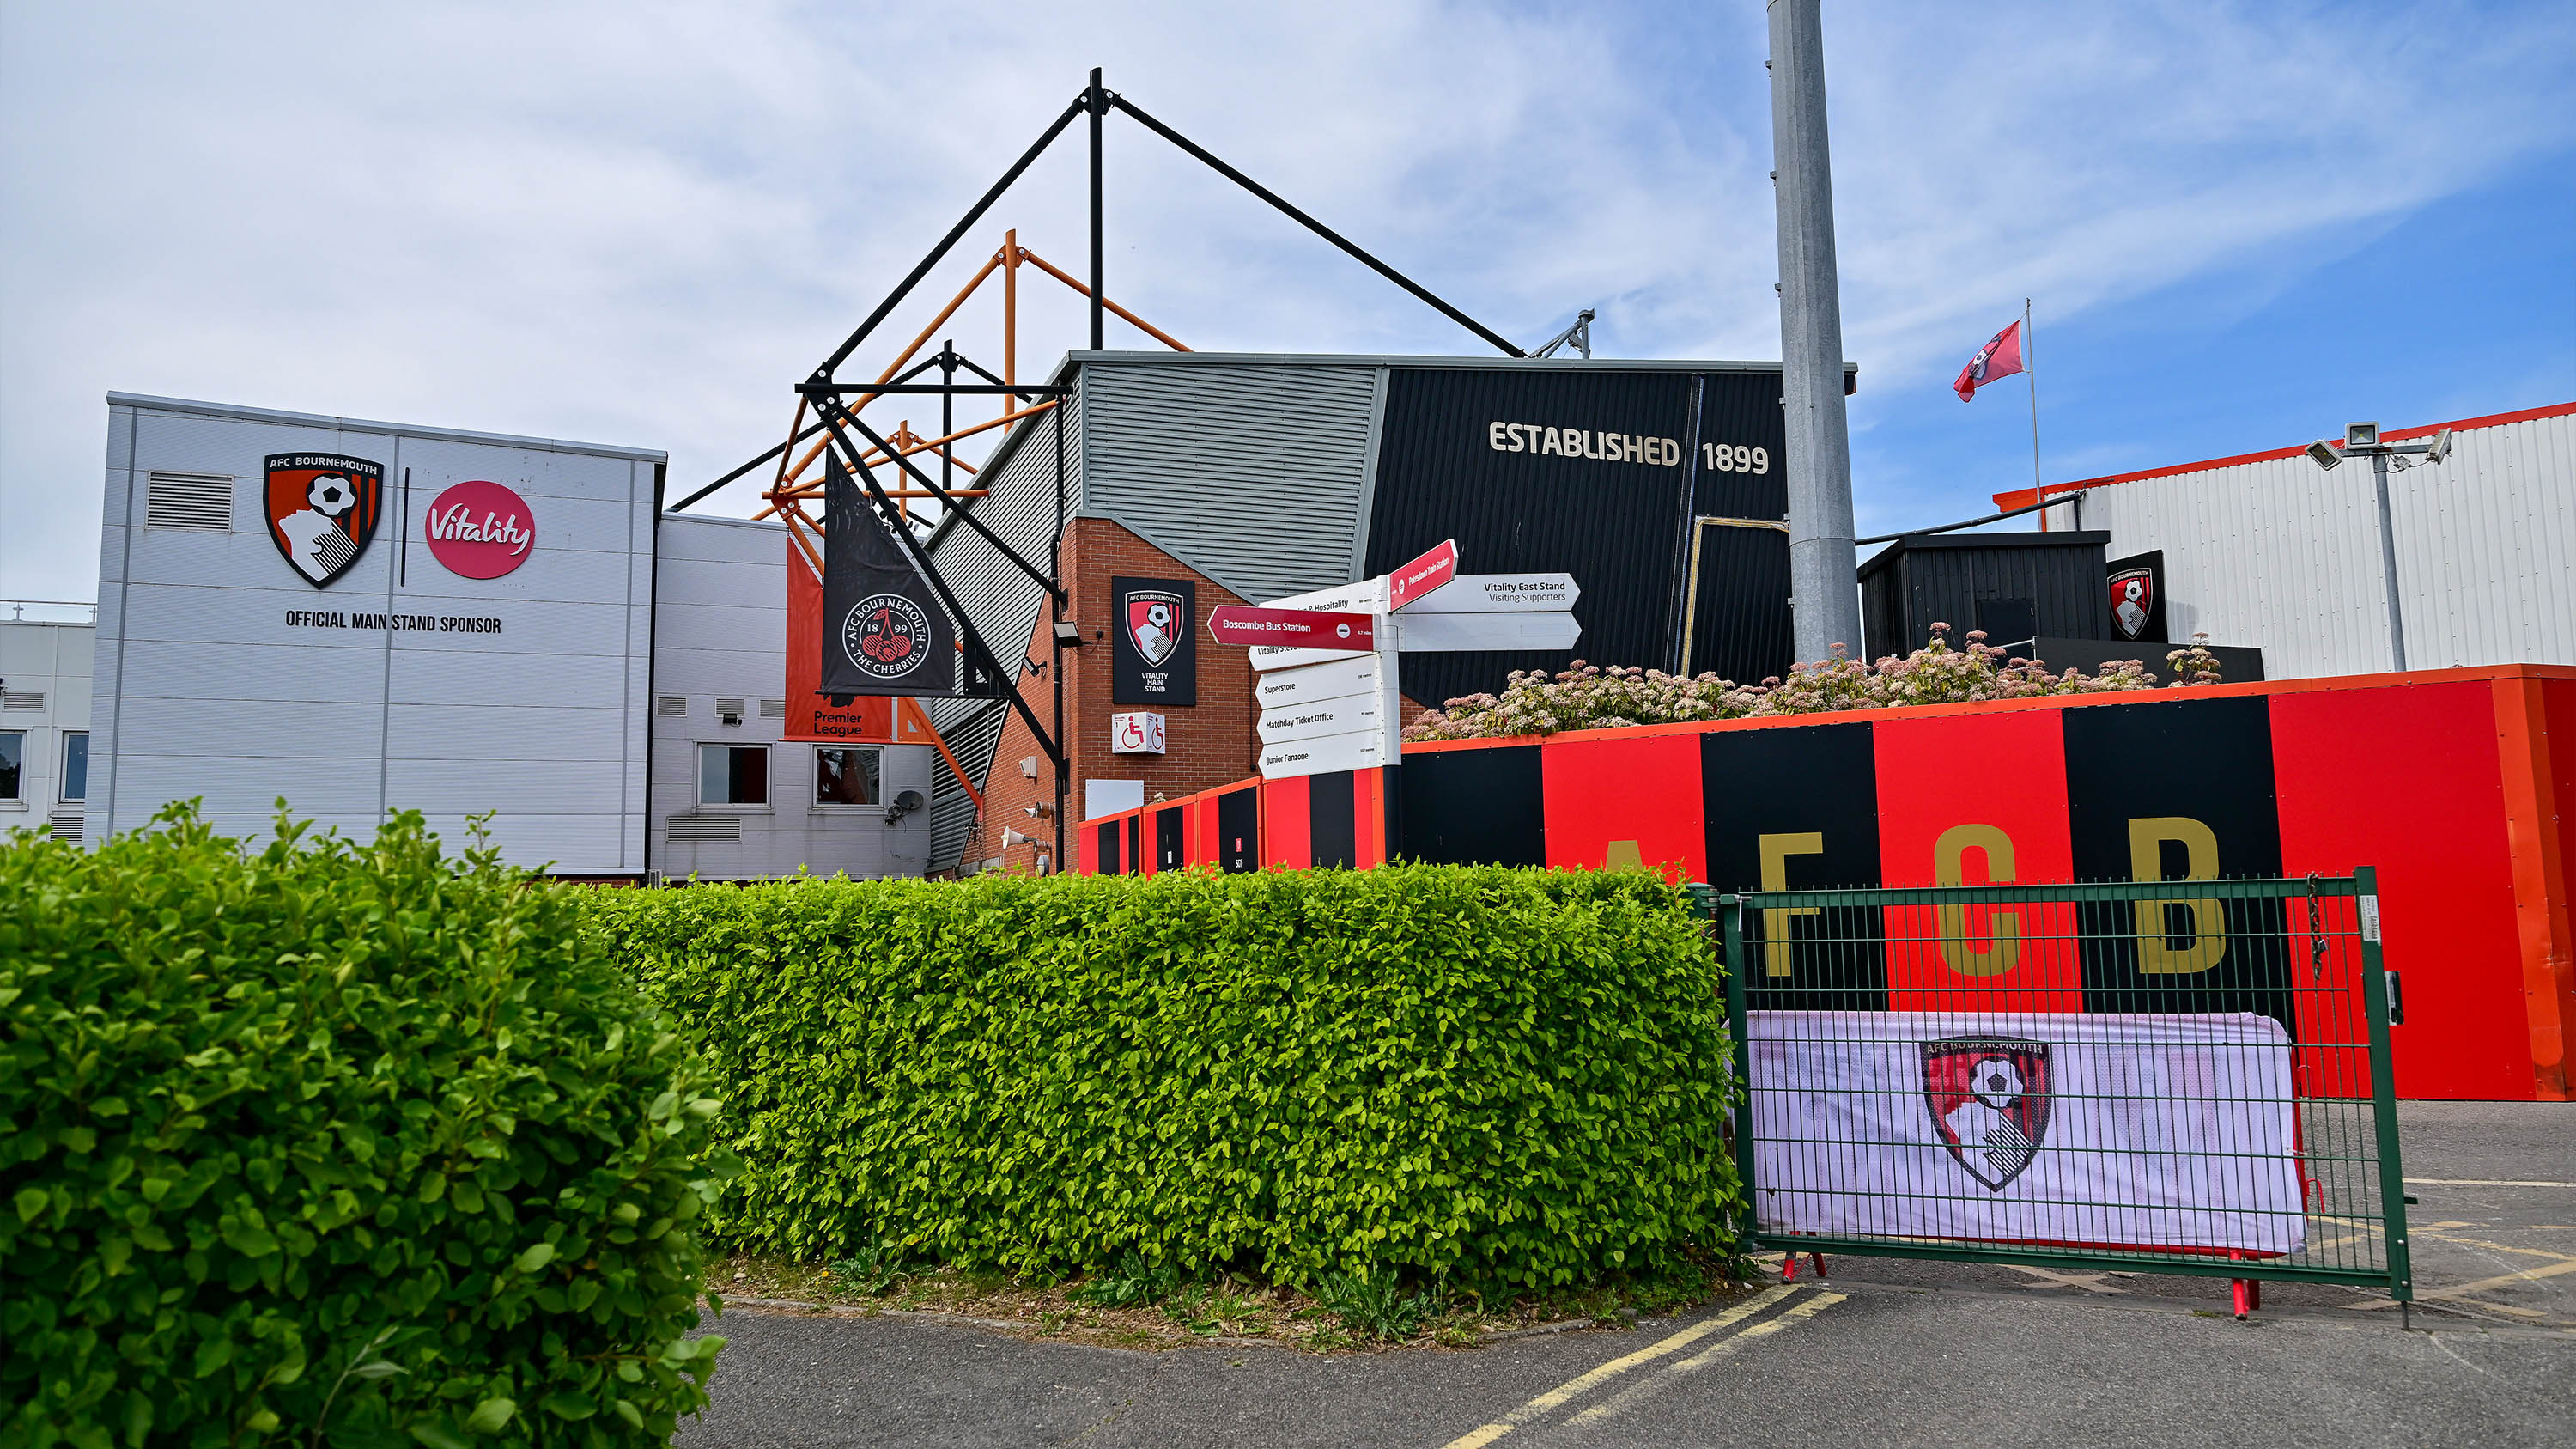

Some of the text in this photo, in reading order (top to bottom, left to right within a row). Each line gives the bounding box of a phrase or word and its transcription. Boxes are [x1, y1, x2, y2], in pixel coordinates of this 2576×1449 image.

[1489, 421, 1769, 474] ESTABLISHED 1899
[270, 456, 378, 475] AFC BOURNEMOUTH
[431, 502, 531, 556] Vitality
[1436, 557, 1449, 570] Station
[1484, 582, 1516, 594] Vitality
[1540, 581, 1565, 591] Stand
[1140, 594, 1180, 604] BOURNEMOUTH
[1490, 593, 1565, 603] Visiting Supporters
[1315, 599, 1349, 612] Hospitality
[286, 610, 501, 633] OFFICIAL MAIN STAND SPONSOR
[847, 597, 927, 642] AFC BOURNEMOUTH
[1223, 619, 1265, 630] Boscombe
[1266, 621, 1281, 631] Bus
[1283, 623, 1311, 632] Station
[867, 624, 908, 633] 18 99
[1258, 646, 1279, 655] Vitality
[854, 649, 920, 674] THE CHERRIES
[1264, 683, 1296, 695] Superstore
[814, 711, 862, 723] Premier
[1266, 718, 1294, 729] Matchday
[1295, 716, 1314, 726] Ticket
[1315, 713, 1334, 721] Office
[814, 724, 862, 737] League
[1267, 753, 1284, 765] Junior
[1284, 752, 1309, 763] Fanzone
[1927, 1042, 1947, 1055] AFC
